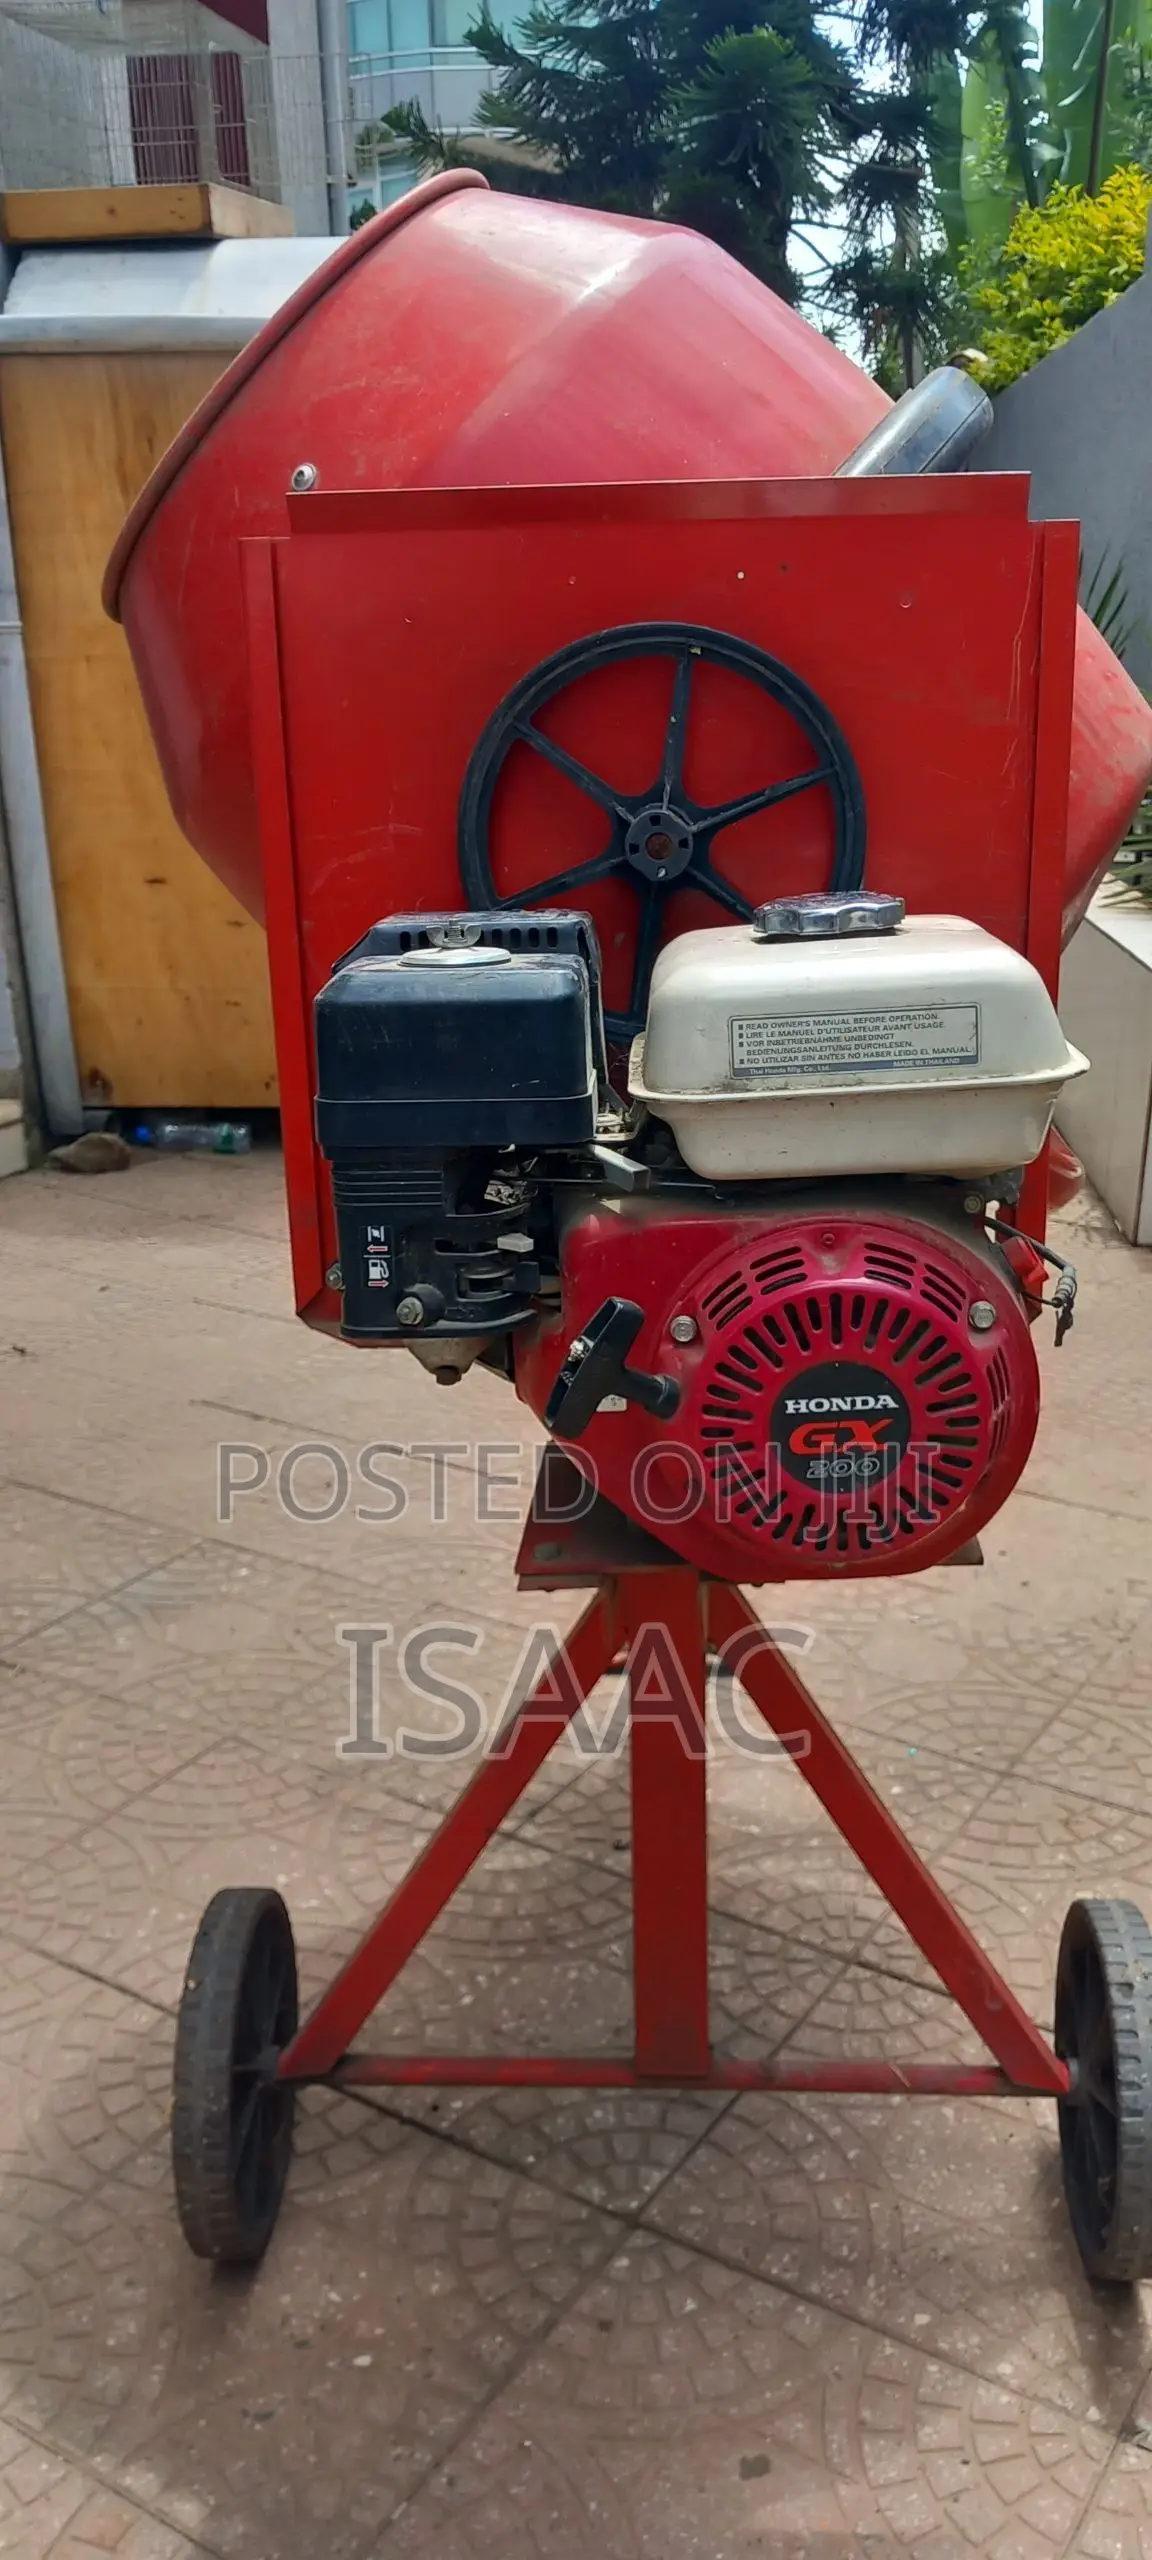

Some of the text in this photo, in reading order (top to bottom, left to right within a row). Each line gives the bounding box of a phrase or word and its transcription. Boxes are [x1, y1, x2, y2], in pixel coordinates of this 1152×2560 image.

[813, 1018, 850, 1026] MANUAL
[854, 1016, 886, 1024] BEFORE
[889, 1013, 939, 1022] OPERATION.
[778, 1028, 814, 1036] MANUEL
[817, 1025, 882, 1035] D'UTILISATEUR
[883, 1023, 912, 1031] AVANT
[766, 1036, 842, 1046] INBETRIEBNAHME
[844, 1033, 894, 1042] UNBEDINGT
[746, 1041, 914, 1056] BEDIENUNGSANLEITUNG DURCHLESEN.
[762, 1056, 798, 1064] UTILIZAR
[818, 1053, 846, 1061] ANTES
[863, 1050, 892, 1058] HABER
[894, 1048, 918, 1056] LEIDO
[932, 1046, 972, 1054] MANUAL.
[924, 1058, 960, 1066] THAILAND
[785, 1394, 899, 1414] HONDA
[789, 1418, 894, 1456] GX
[806, 1458, 881, 1479] 200
